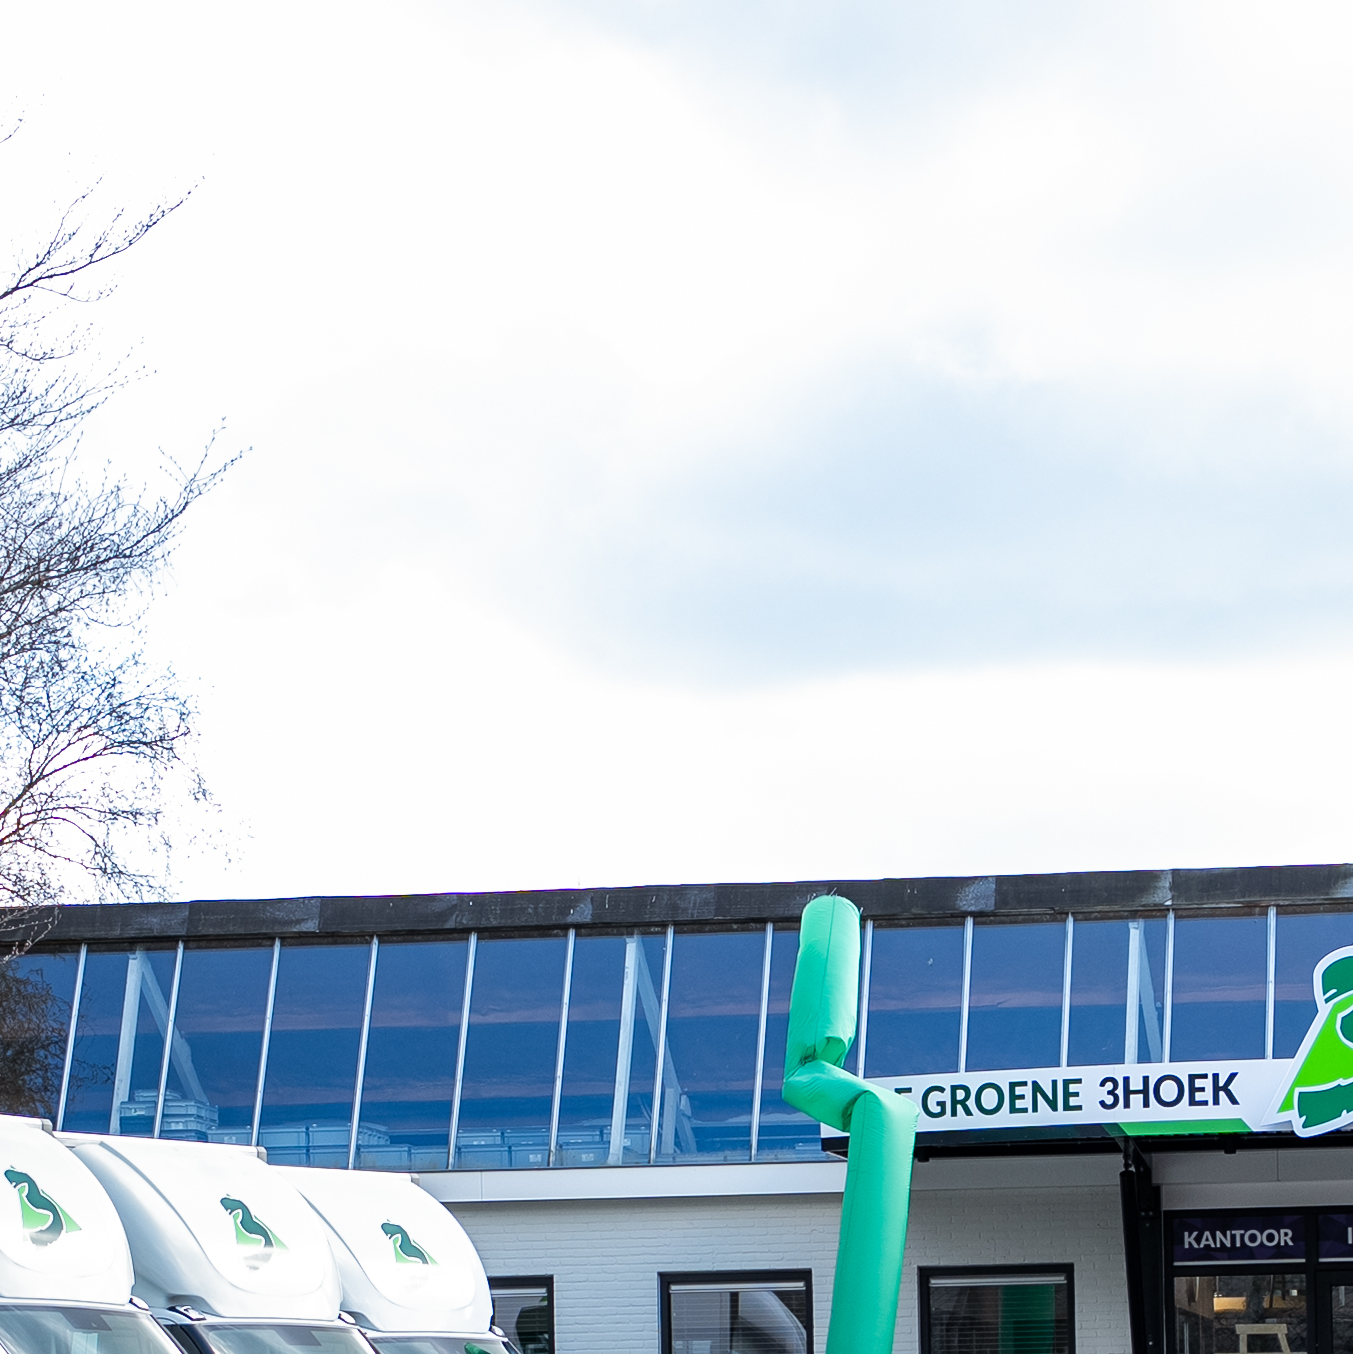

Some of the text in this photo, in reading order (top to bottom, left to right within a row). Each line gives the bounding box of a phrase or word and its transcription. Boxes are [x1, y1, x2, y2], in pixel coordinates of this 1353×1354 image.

[921, 1071, 1241, 1119] GROENE 3HOEK
[1183, 1228, 1294, 1249] KANTOOR
